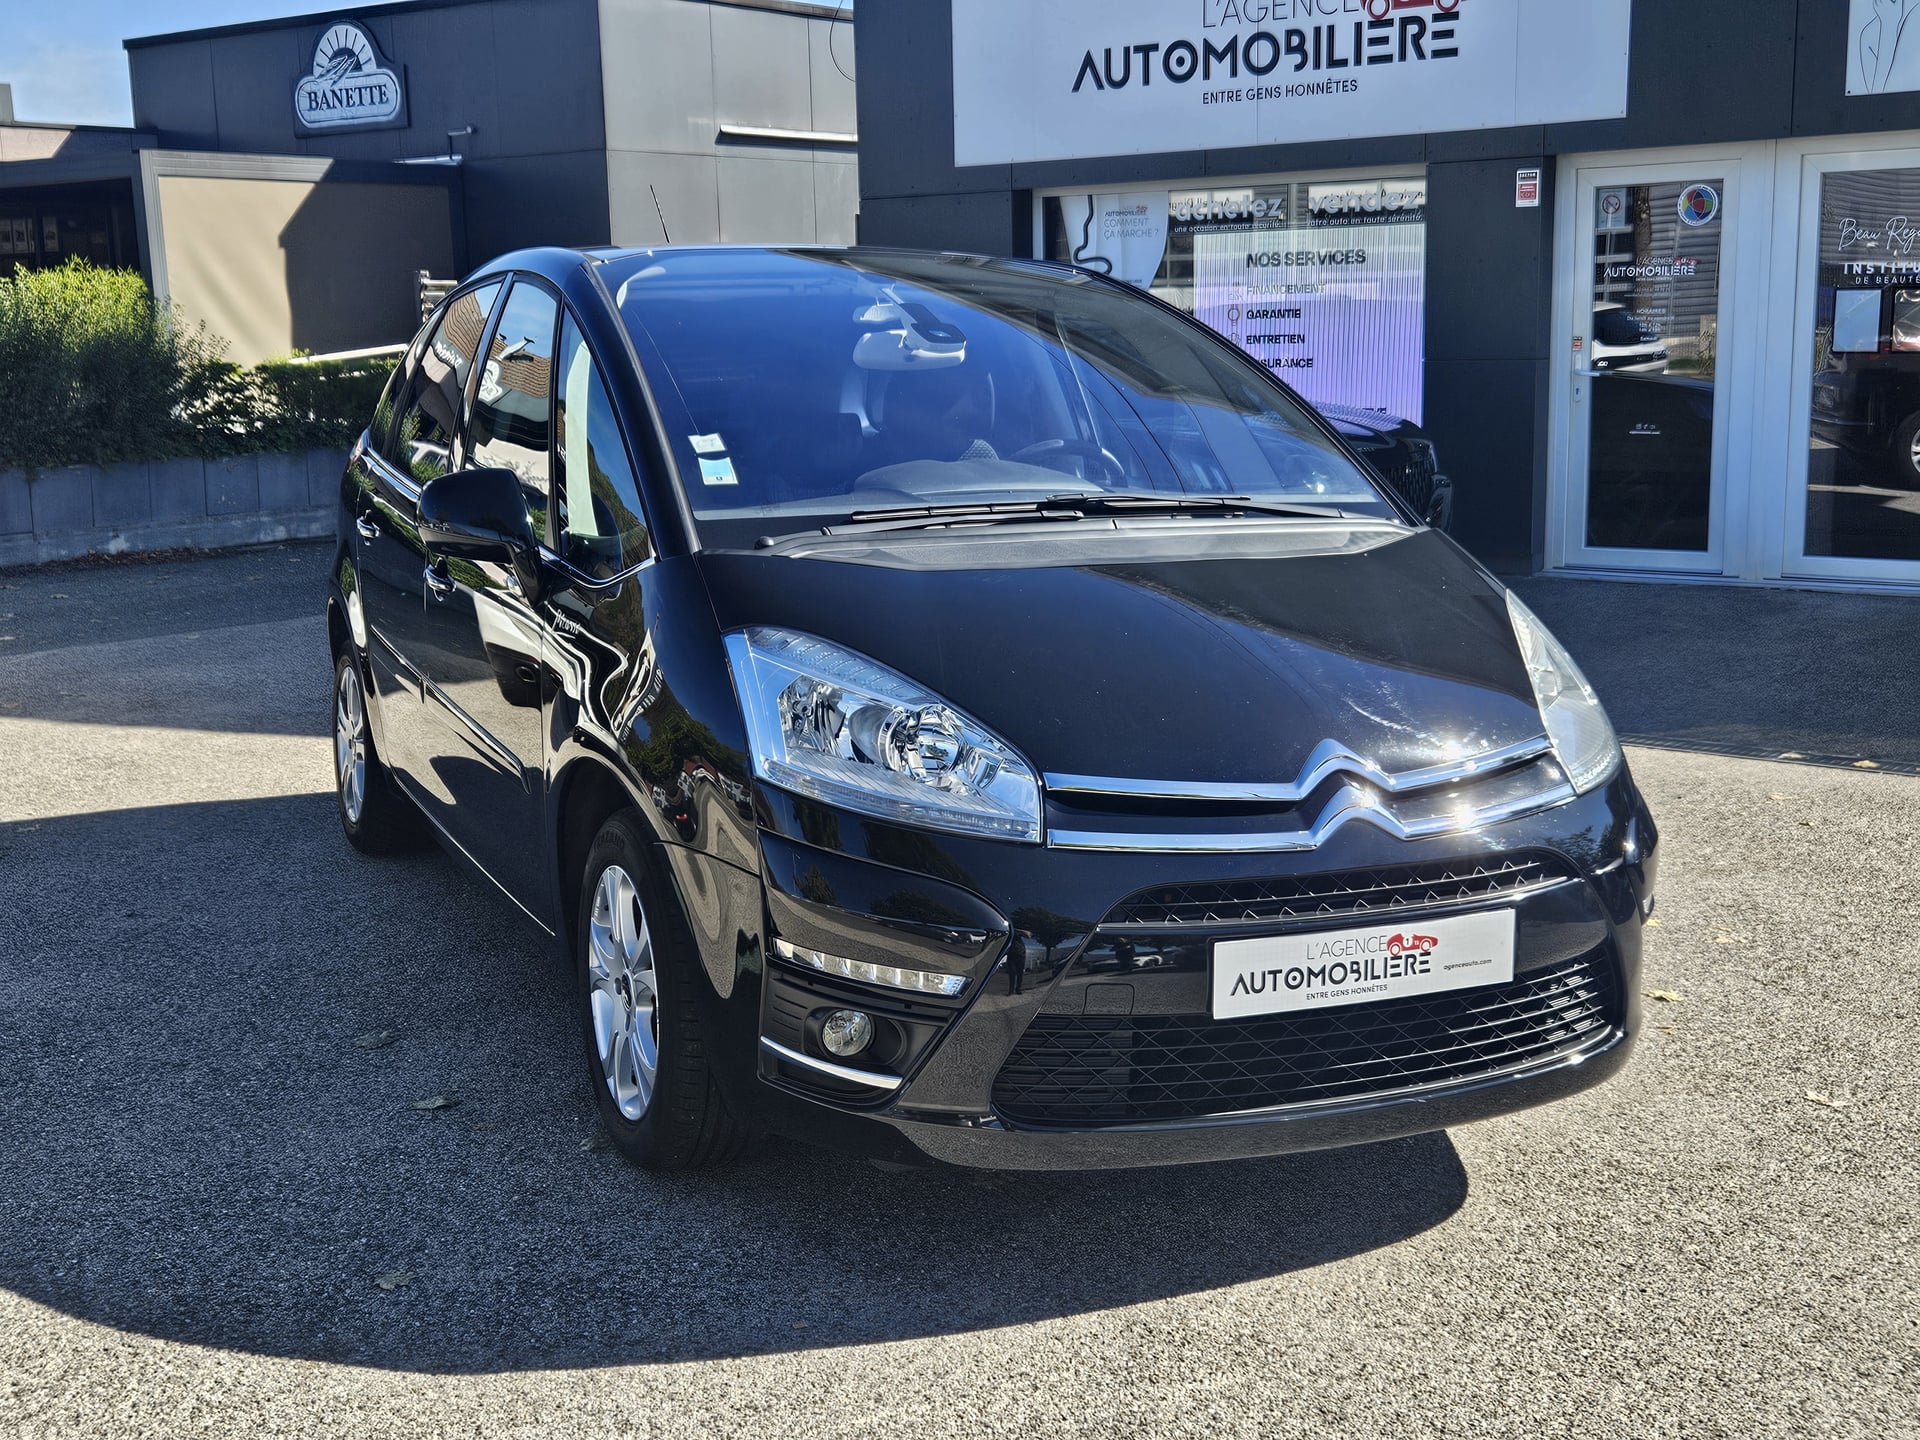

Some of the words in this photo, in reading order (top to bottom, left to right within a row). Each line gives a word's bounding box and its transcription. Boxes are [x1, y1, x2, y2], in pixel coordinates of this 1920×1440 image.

[307, 84, 389, 112] BANETTE
[1203, 89, 1242, 105] ENTRE
[1246, 86, 1281, 100] GENS
[1285, 79, 1358, 97] HONNÊTES
[1309, 181, 1420, 214] vendez
[1103, 217, 1149, 229] COMMENT
[1103, 229, 1116, 240] ÇA
[1117, 227, 1153, 239] MARCHE
[1838, 217, 1881, 252] Beau
[1246, 252, 1281, 269] NOS
[1284, 248, 1367, 267] SERVICES
[1855, 276, 1869, 285] DE
[1246, 282, 1326, 296] FINANCEMENT
[1246, 308, 1301, 320] GARANTIE
[1246, 334, 1305, 345] ENTRETIEN
[1259, 357, 1314, 369] SURANCE
[1306, 935, 1387, 960] L'AGENCE
[1306, 991, 1329, 1000] ENTRE
[1330, 988, 1350, 998] GENS
[1351, 984, 1388, 996] HONNÊTES
